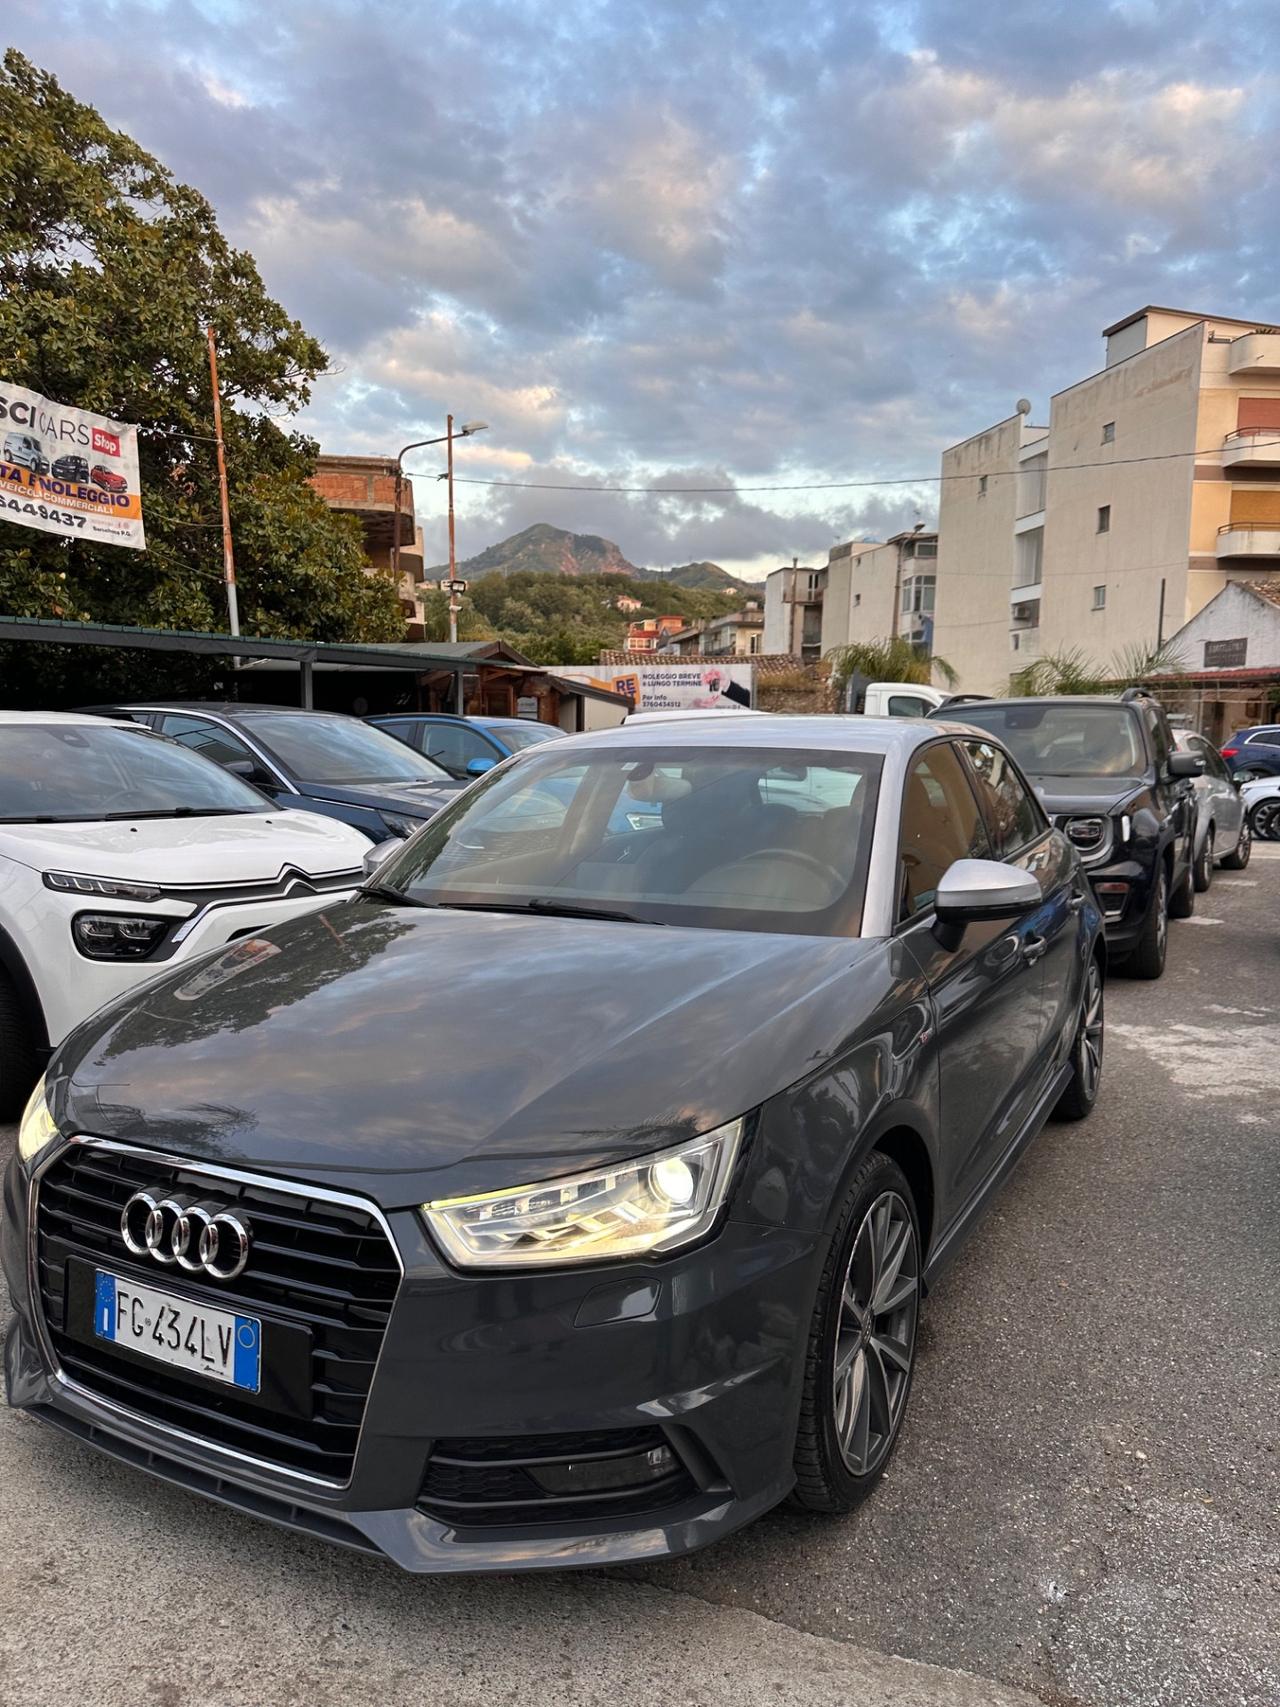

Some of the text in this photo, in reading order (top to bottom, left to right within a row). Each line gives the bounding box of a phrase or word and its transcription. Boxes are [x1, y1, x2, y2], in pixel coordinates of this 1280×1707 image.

[39, 476, 131, 508] NOLEGGIO
[43, 492, 114, 515] COMMERCIALI
[616, 678, 635, 692] RE
[654, 693, 668, 701] info
